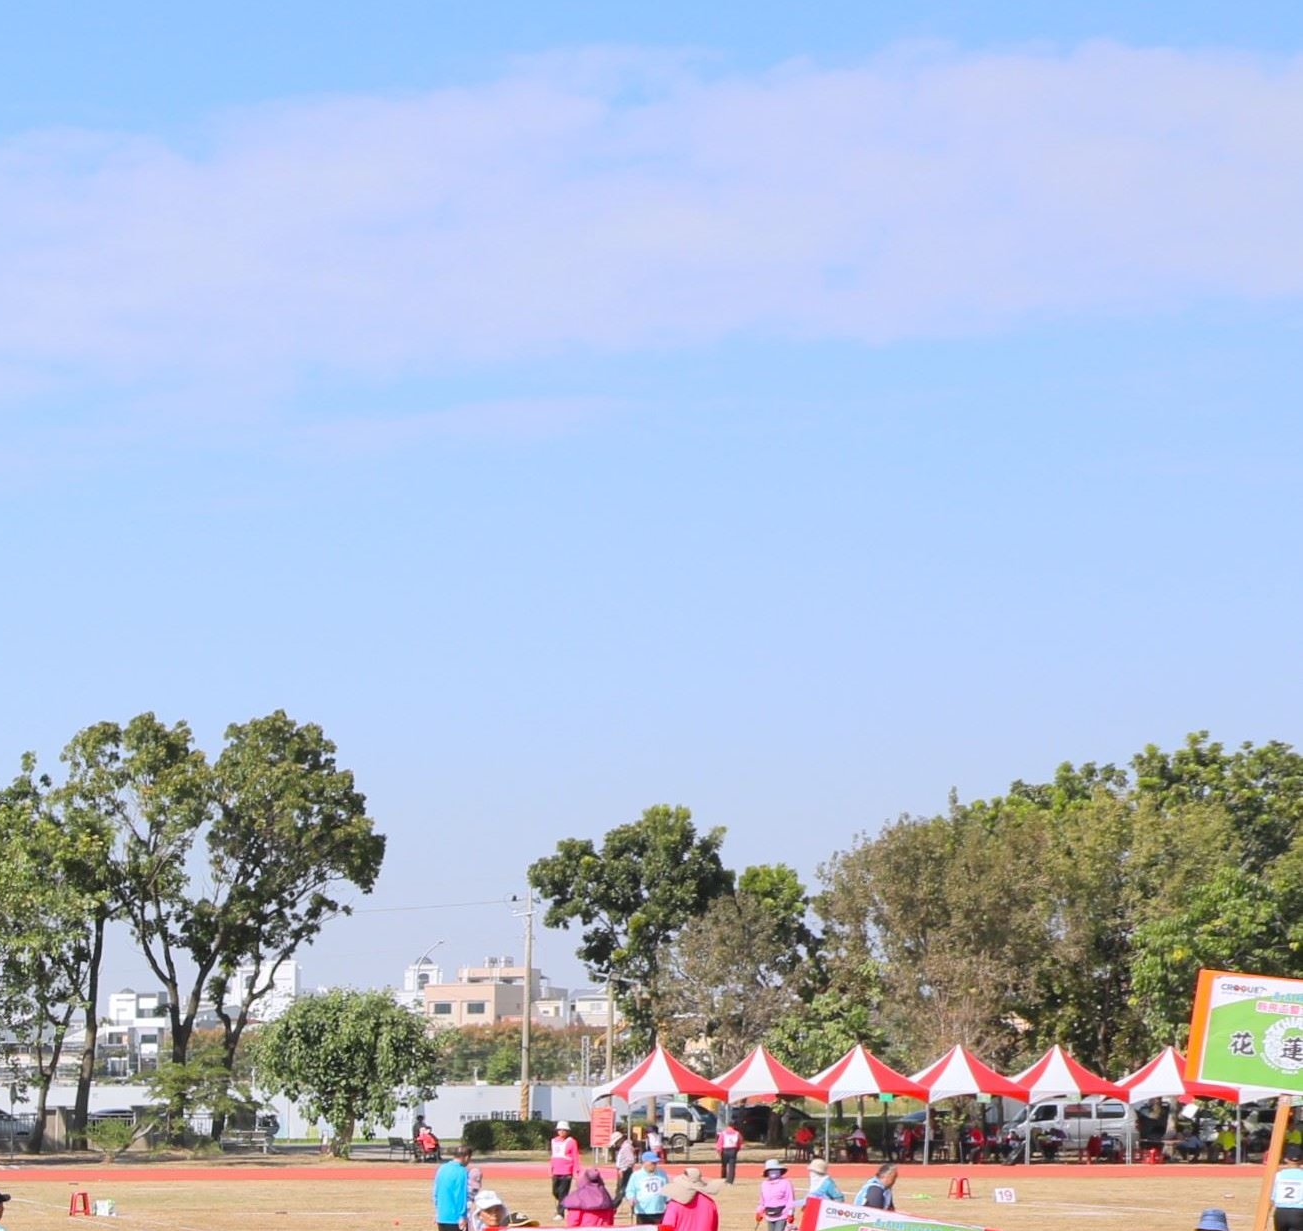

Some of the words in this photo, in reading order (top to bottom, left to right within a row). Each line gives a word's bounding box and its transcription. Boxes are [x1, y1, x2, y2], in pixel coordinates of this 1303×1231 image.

[645, 1182, 659, 1193] 10
[1283, 1187, 1295, 1199] 2
[998, 1190, 1013, 1201] 19
[826, 1207, 870, 1220] CROQUET
